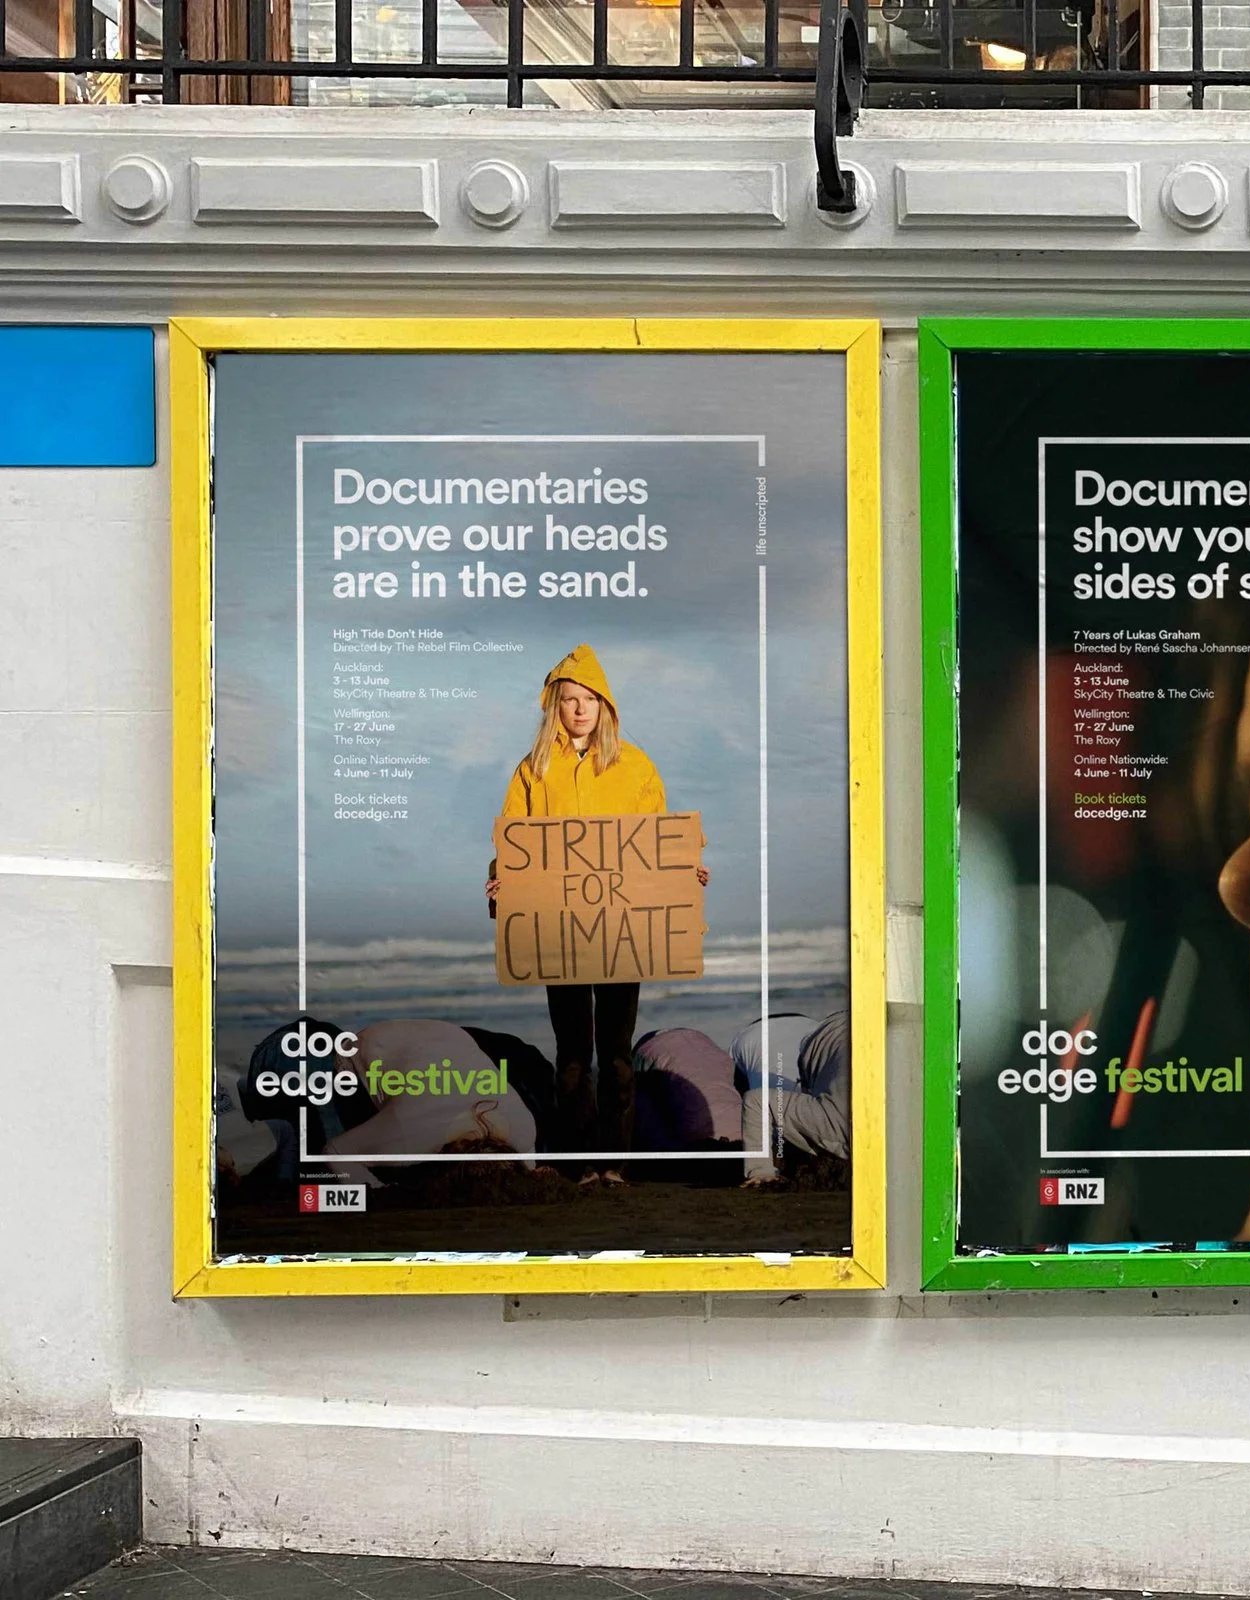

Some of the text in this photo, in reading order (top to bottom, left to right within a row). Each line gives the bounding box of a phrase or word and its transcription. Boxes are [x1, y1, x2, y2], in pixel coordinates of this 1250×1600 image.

[334, 467, 648, 504] Documentaries
[755, 477, 768, 555] life unscripted
[334, 514, 668, 560] prove our heads
[1074, 516, 1183, 553] show
[333, 561, 648, 598] are in the sand.
[1074, 562, 1176, 599] sides
[1188, 562, 1229, 599] of
[333, 629, 443, 641] High Tide Don't Hide
[1074, 630, 1200, 640] 7 Years of Lukas Graham
[333, 641, 523, 654] Directed by The Rebel Film Collective
[1074, 643, 1116, 653] Directed
[1120, 643, 1132, 655] by
[1135, 643, 1160, 652] René
[1162, 643, 1197, 653] Sascha
[334, 662, 383, 673] Auckland:
[1074, 663, 1123, 673] Auckland:
[333, 676, 340, 685] 3
[350, 676, 361, 685] 13
[363, 676, 390, 685] June
[1074, 677, 1080, 686] 3
[1090, 677, 1101, 686] 13
[1103, 676, 1129, 686] June
[333, 688, 478, 700] SkyCity Theatre & The Civic
[1074, 689, 1214, 700] SkyCity Theatre & The Civic
[334, 708, 391, 720] Wellington:
[1074, 709, 1130, 720] Wellington:
[334, 722, 344, 732] 17
[354, 722, 367, 731] 27
[369, 721, 395, 731] June
[1074, 723, 1085, 731] 17
[1094, 722, 1106, 731] 27
[1108, 722, 1134, 732] June
[334, 734, 381, 747] The Roxy
[1074, 734, 1120, 747] The Roxy
[334, 753, 430, 764] Online Nationwide:
[1074, 754, 1168, 764] Online Nationwide:
[334, 769, 341, 777] 4
[344, 768, 370, 778] June
[380, 768, 388, 778] 11
[391, 768, 413, 780] July
[1074, 769, 1081, 777] 4
[1084, 768, 1109, 777] June
[1119, 768, 1127, 777] 11
[1130, 768, 1152, 779] July
[334, 792, 407, 805] Book tickets
[1074, 792, 1146, 804] Book tickets
[334, 806, 408, 820] docedge.nz
[1074, 807, 1146, 820] docedge.nz
[503, 815, 695, 872] STRIKE
[562, 872, 631, 907] FOR
[504, 904, 696, 981] CLIMATE
[281, 1021, 358, 1057] doc
[1022, 1020, 1098, 1055] doc
[256, 1059, 508, 1105] edge festival
[998, 1057, 1242, 1103] edge festival
[326, 1190, 359, 1206] RNZ
[1066, 1184, 1098, 1199] RNZ
